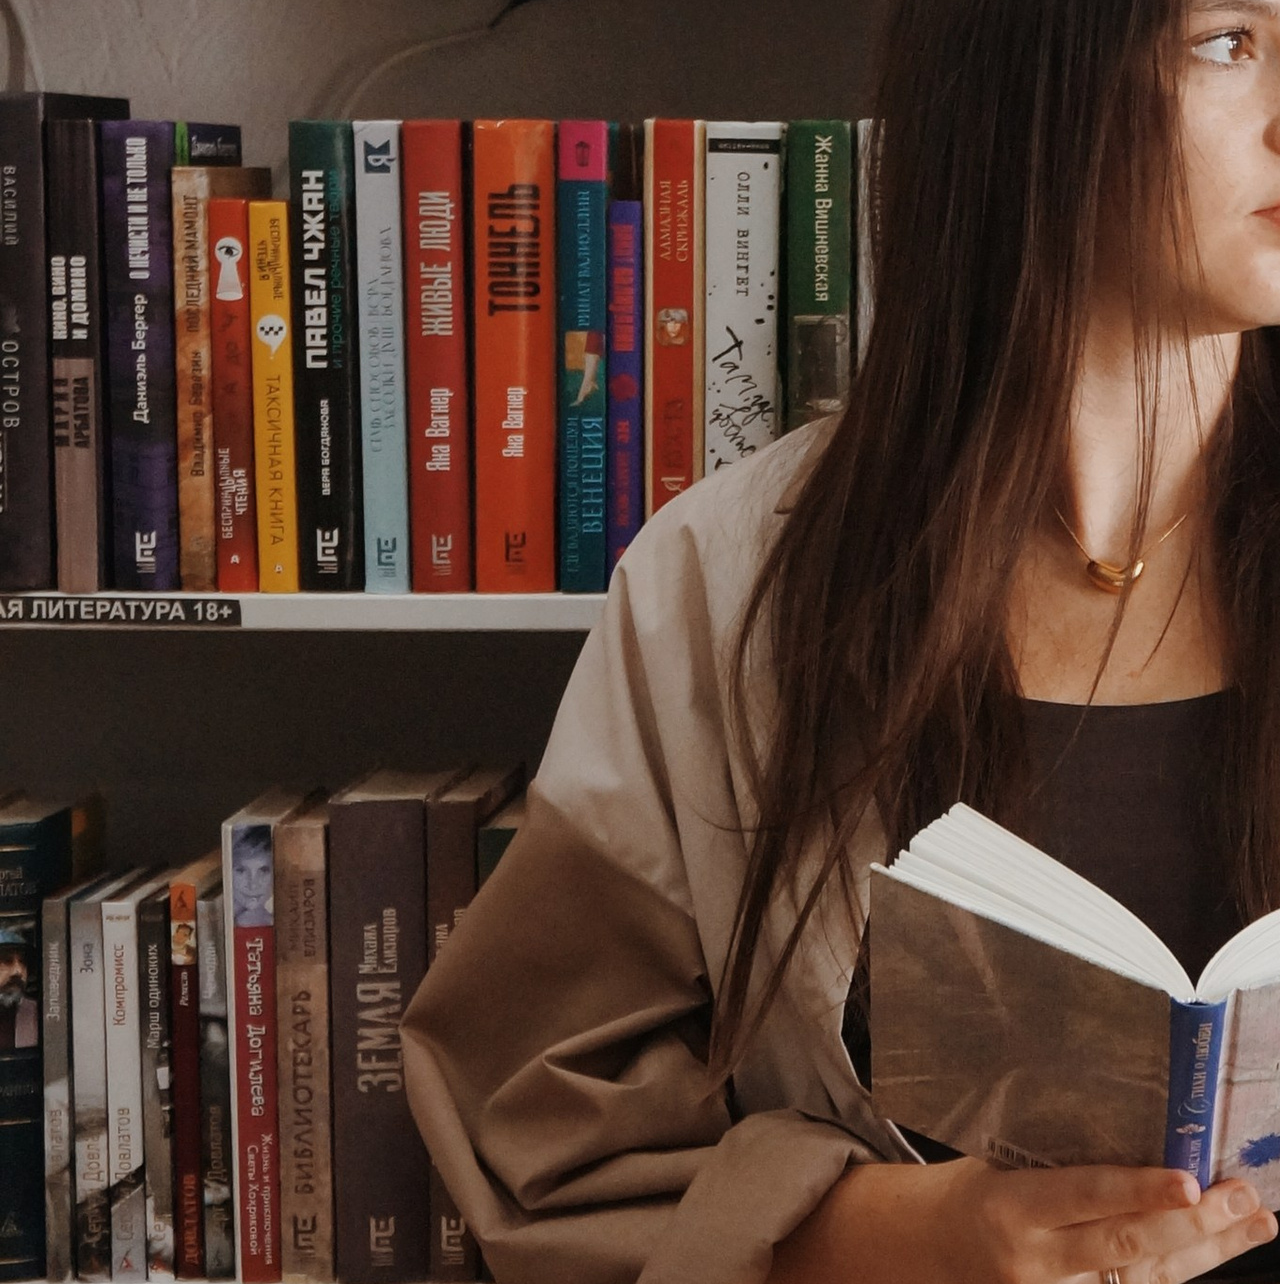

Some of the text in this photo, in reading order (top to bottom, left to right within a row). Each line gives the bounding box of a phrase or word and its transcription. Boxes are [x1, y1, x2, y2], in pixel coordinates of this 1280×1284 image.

[301, 168, 328, 369] ПАВЕЛ ЧЖАН
[418, 191, 453, 336] ЖИВЫЕ ЛЮДИ
[488, 184, 541, 317] ТОННЕЛЬ
[737, 172, 751, 296] ОЛЛИ ВИНГЕТ
[814, 135, 833, 302] Жанна Вишневская
[131, 295, 150, 424] Даниэль Бергер
[424, 388, 453, 472] Яна Вагнер
[502, 387, 527, 458] Яна Вагнер
[581, 417, 603, 534] ВЕНЕЦИЯ
[31, 601, 186, 621] ЛИТЕРАТУРА
[193, 601, 233, 621] 18+
[47, 941, 61, 1022] Заповедник
[112, 944, 128, 1026] Компромисс
[147, 944, 160, 1049] Марш одиноких
[245, 938, 266, 1117] Татьяна Догилева
[356, 981, 402, 1094] ЗЕМЛЯ
[291, 989, 313, 1195] БИБЛИОТЕКАРЬ
